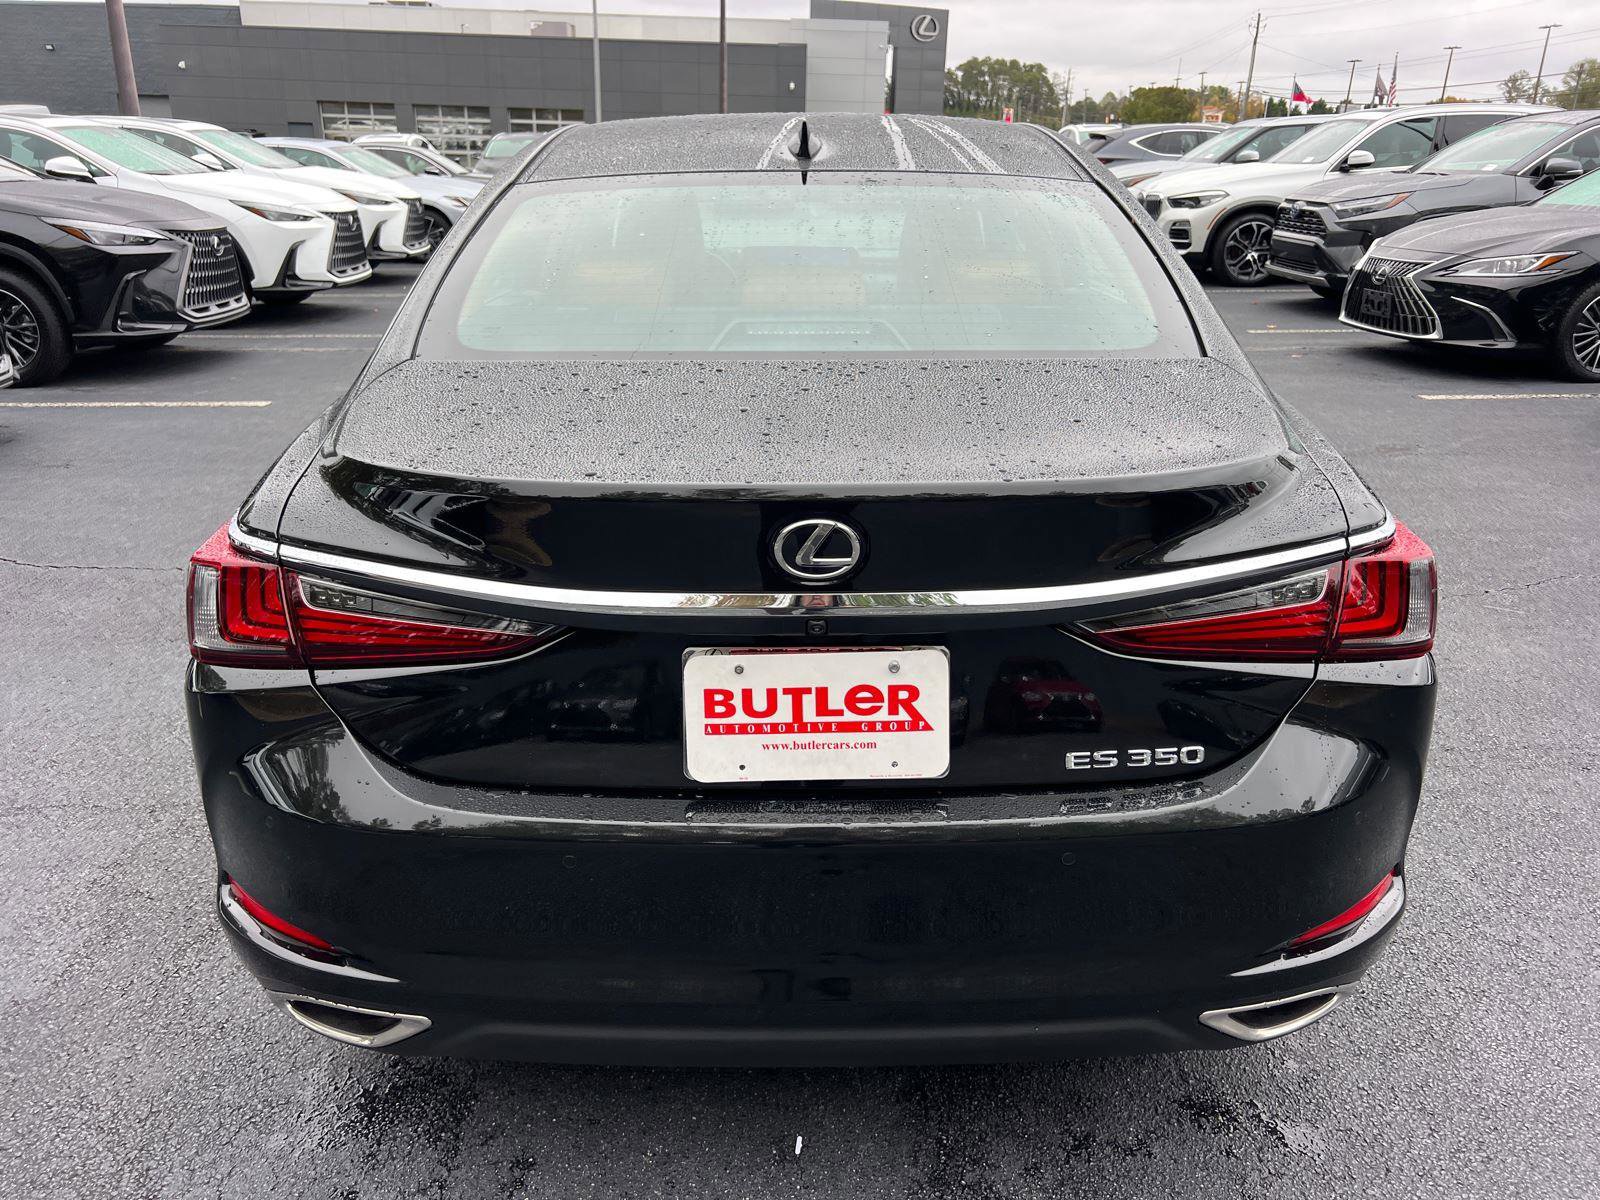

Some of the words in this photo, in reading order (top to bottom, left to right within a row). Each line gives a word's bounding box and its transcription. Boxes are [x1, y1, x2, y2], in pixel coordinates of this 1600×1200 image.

[706, 722, 838, 734] AUTOMOTIVE
[861, 720, 926, 731] GROUP
[761, 739, 877, 751] www.butlercars.com
[1065, 750, 1119, 770] ES
[1126, 745, 1205, 767] 350
